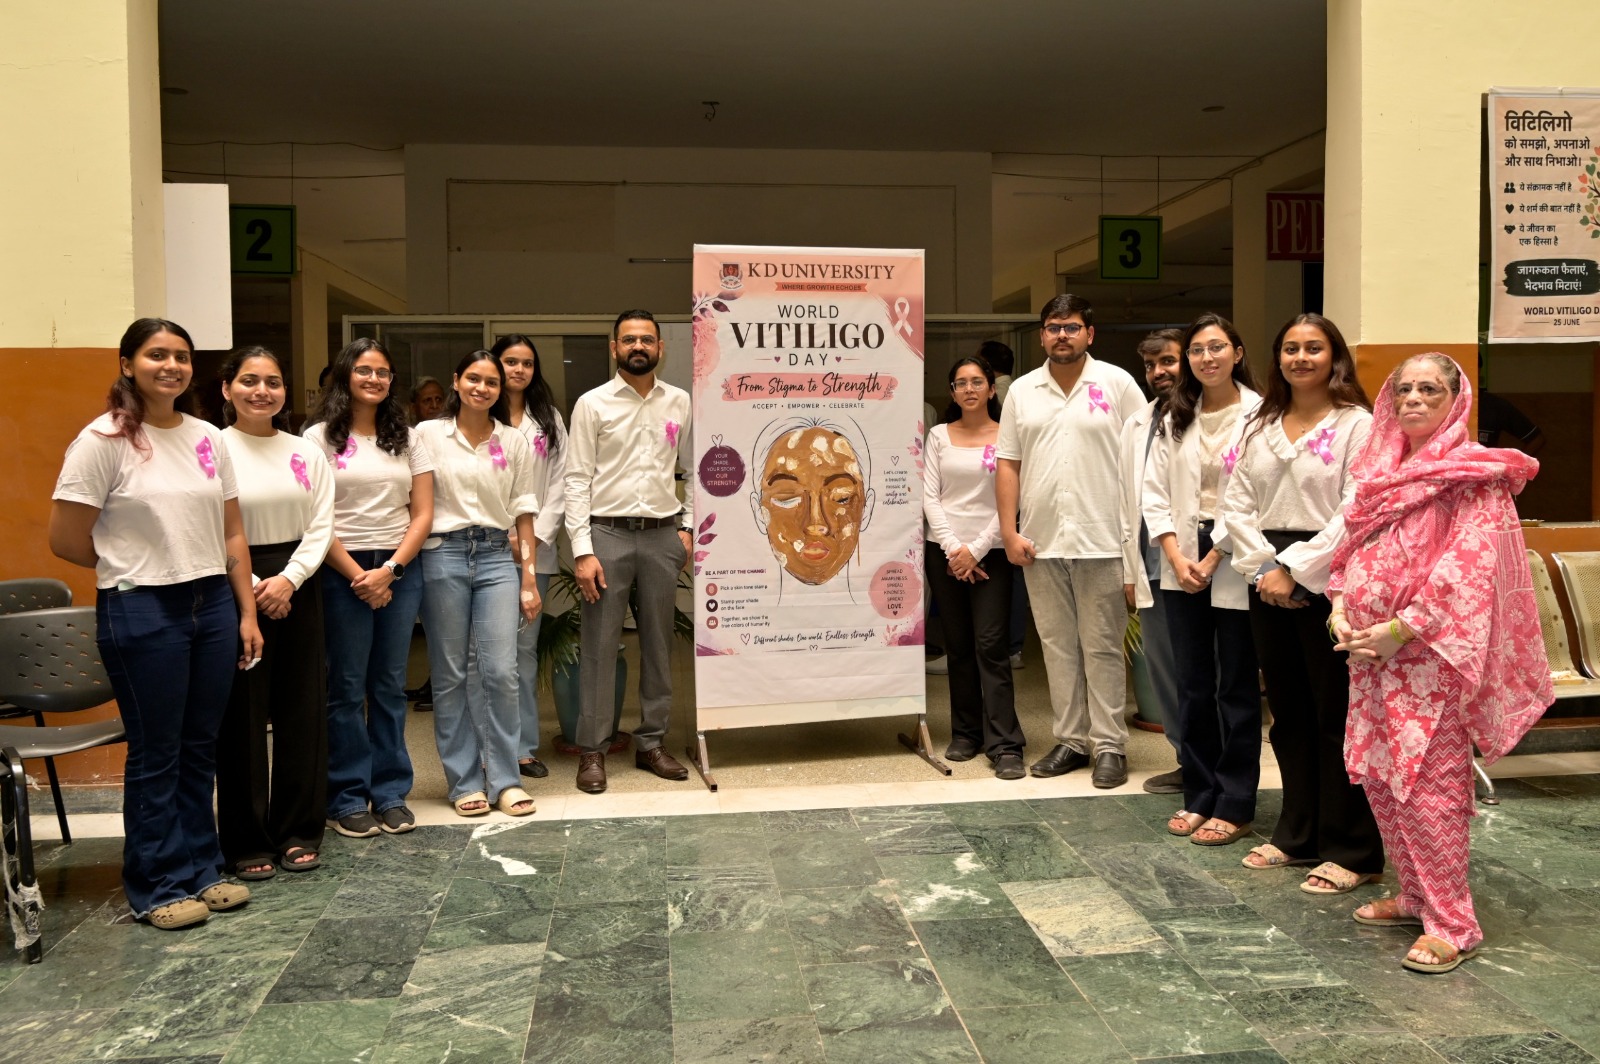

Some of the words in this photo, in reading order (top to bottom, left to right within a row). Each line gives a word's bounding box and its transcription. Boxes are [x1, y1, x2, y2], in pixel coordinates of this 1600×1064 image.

[1504, 110, 1573, 131] विटिलिगो
[1504, 136, 1517, 149] को
[1519, 136, 1550, 150] समझो,
[1553, 136, 1590, 149] अपनाओ
[1504, 153, 1521, 166] और
[1523, 156, 1543, 166] साथ
[1545, 153, 1581, 166] निभाओ।
[1519, 182, 1525, 191] ये
[1526, 182, 1553, 191] संक्रामक
[1554, 182, 1567, 192] नहीं
[1567, 182, 1572, 192] है
[1519, 203, 1525, 212] ये
[1526, 203, 1538, 212] शर्म
[1539, 203, 1549, 213] की
[1550, 205, 1562, 213] बात
[1563, 203, 1576, 213] नहीं
[1576, 203, 1581, 213] है
[1519, 223, 1525, 232] ये
[1526, 223, 1545, 233] जीवन
[246, 219, 272, 261] 2
[1519, 238, 1532, 246] एक
[1533, 236, 1552, 246] हिस्सा
[1553, 235, 1559, 246] है
[1119, 229, 1141, 269] 3
[781, 263, 895, 280] UNIVERSITY
[1561, 262, 1589, 276] फैलाएं,
[1524, 279, 1554, 291] भेदभाव
[1555, 279, 1582, 291] मिटाएं!
[777, 304, 839, 319] WORLD
[1524, 307, 1554, 315] WORLD
[1557, 306, 1592, 315] VITILIGO
[730, 322, 885, 350] VITILIGO
[788, 353, 828, 366] DAY
[737, 375, 764, 396] From
[768, 377, 806, 398] Stigma
[808, 378, 818, 392] to
[822, 371, 882, 401] Strength
[825, 629, 848, 641] Endless
